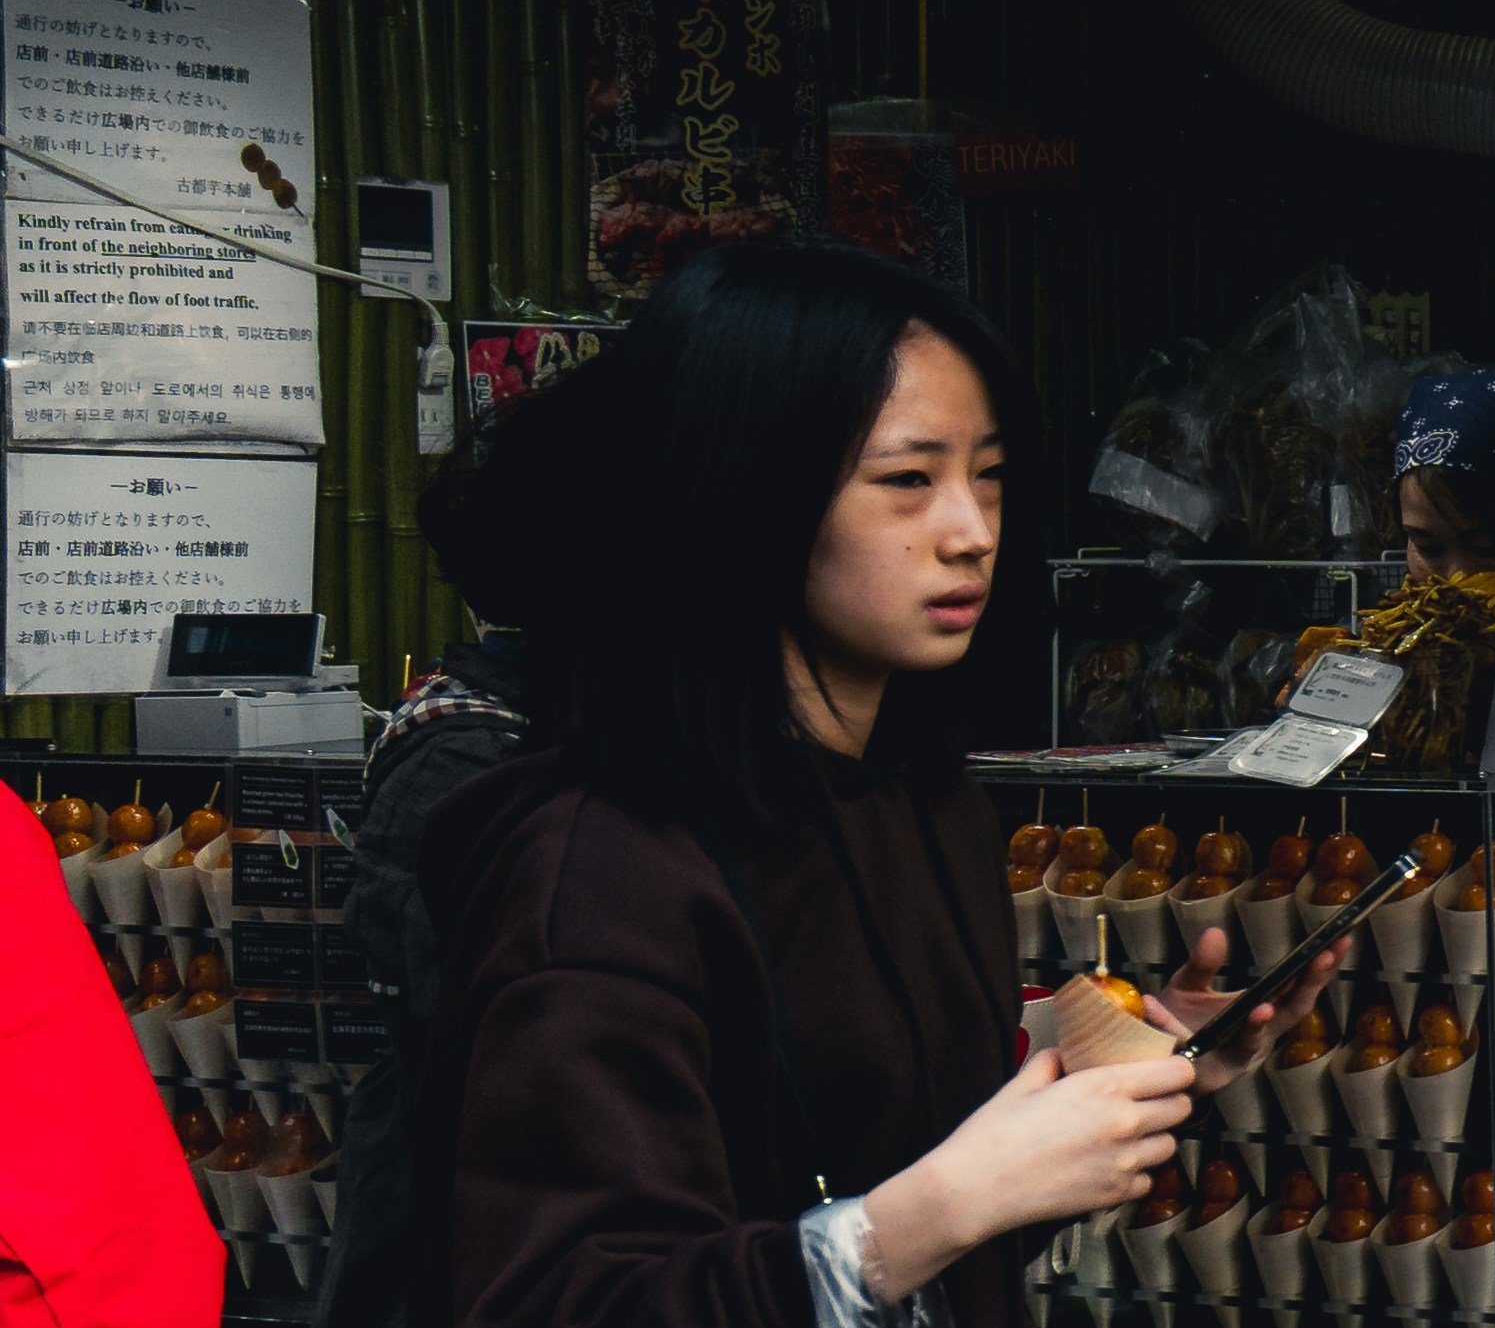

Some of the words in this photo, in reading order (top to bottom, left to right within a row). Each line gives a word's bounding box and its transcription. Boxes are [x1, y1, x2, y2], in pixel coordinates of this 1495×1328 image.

[15, 13, 211, 51] 通行の妨げとなりますので、
[18, 75, 228, 111] でのご飲食はお控えください。
[958, 139, 1077, 176] TERIYAKI
[177, 179, 251, 198] 古都芋本舗
[18, 214, 70, 232] Kindly
[75, 217, 126, 232] refrain
[131, 219, 165, 234] from
[234, 224, 293, 244] drinking
[18, 240, 33, 251] in
[39, 240, 77, 253] front
[82, 241, 97, 254] of
[101, 241, 124, 255] the
[129, 242, 214, 260] neighboring
[19, 263, 35, 274] as
[39, 261, 51, 274] it
[55, 261, 69, 274] is
[73, 261, 125, 279] strictly
[130, 266, 205, 280] prohibited
[208, 266, 234, 280] and
[20, 291, 50, 304] will
[54, 291, 97, 305] affect
[101, 291, 124, 305] the
[129, 292, 161, 306] flow
[165, 293, 180, 307] of
[183, 294, 210, 308] foot
[214, 295, 259, 311] traffic.
[23, 381, 52, 396] 근처
[152, 384, 223, 398] 도로에서의
[24, 409, 67, 423] 방해가
[17, 511, 212, 529] 通行の妨げとなりますので、
[19, 571, 226, 586] でのご飲食はお控えください。
[17, 629, 163, 645] お願い申し上げます。
